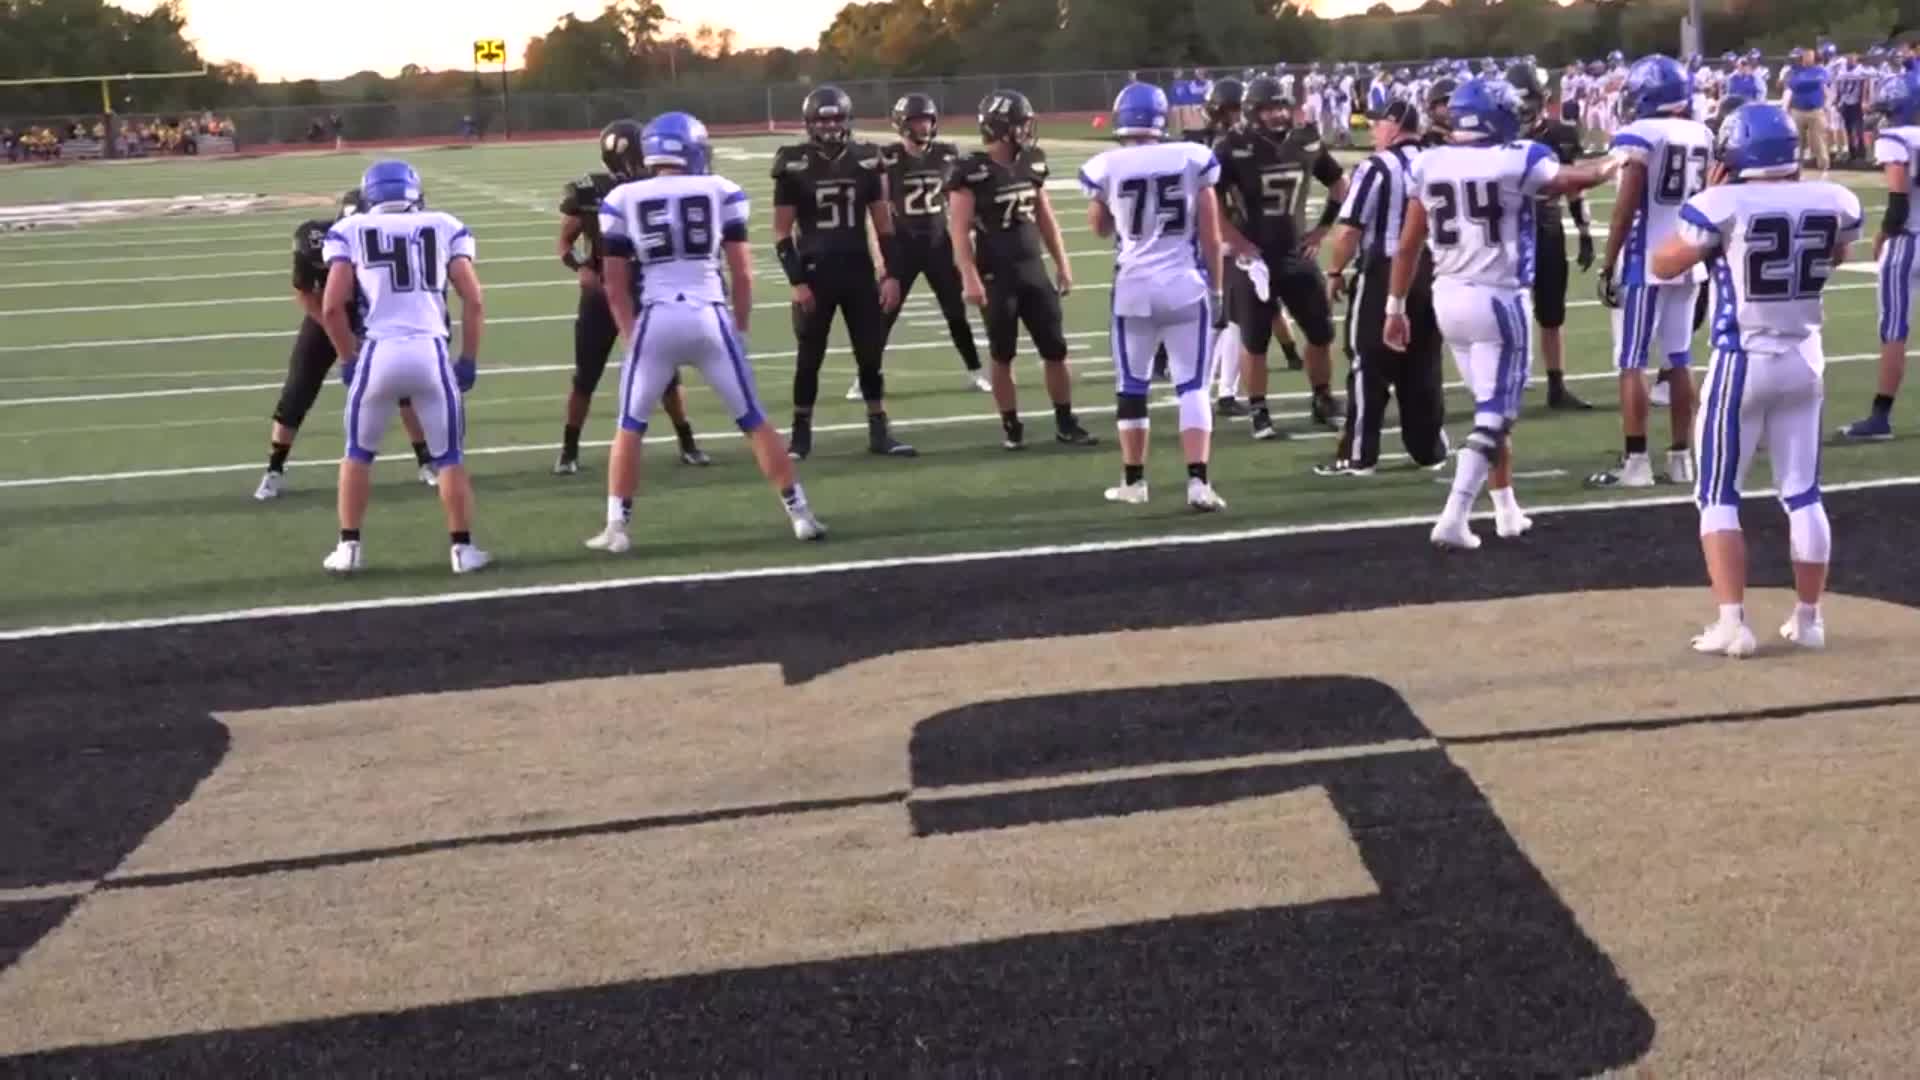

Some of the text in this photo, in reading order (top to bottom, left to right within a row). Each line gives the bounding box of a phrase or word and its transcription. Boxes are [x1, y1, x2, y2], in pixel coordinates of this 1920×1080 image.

[477, 40, 504, 64] 25
[816, 187, 856, 228] 51
[904, 177, 943, 215] 22
[1119, 173, 1188, 240] 75
[1261, 170, 1304, 216] 57
[1427, 179, 1504, 248] 24
[360, 225, 442, 292] 41
[637, 195, 713, 264] 58
[1744, 209, 1840, 302] 22
